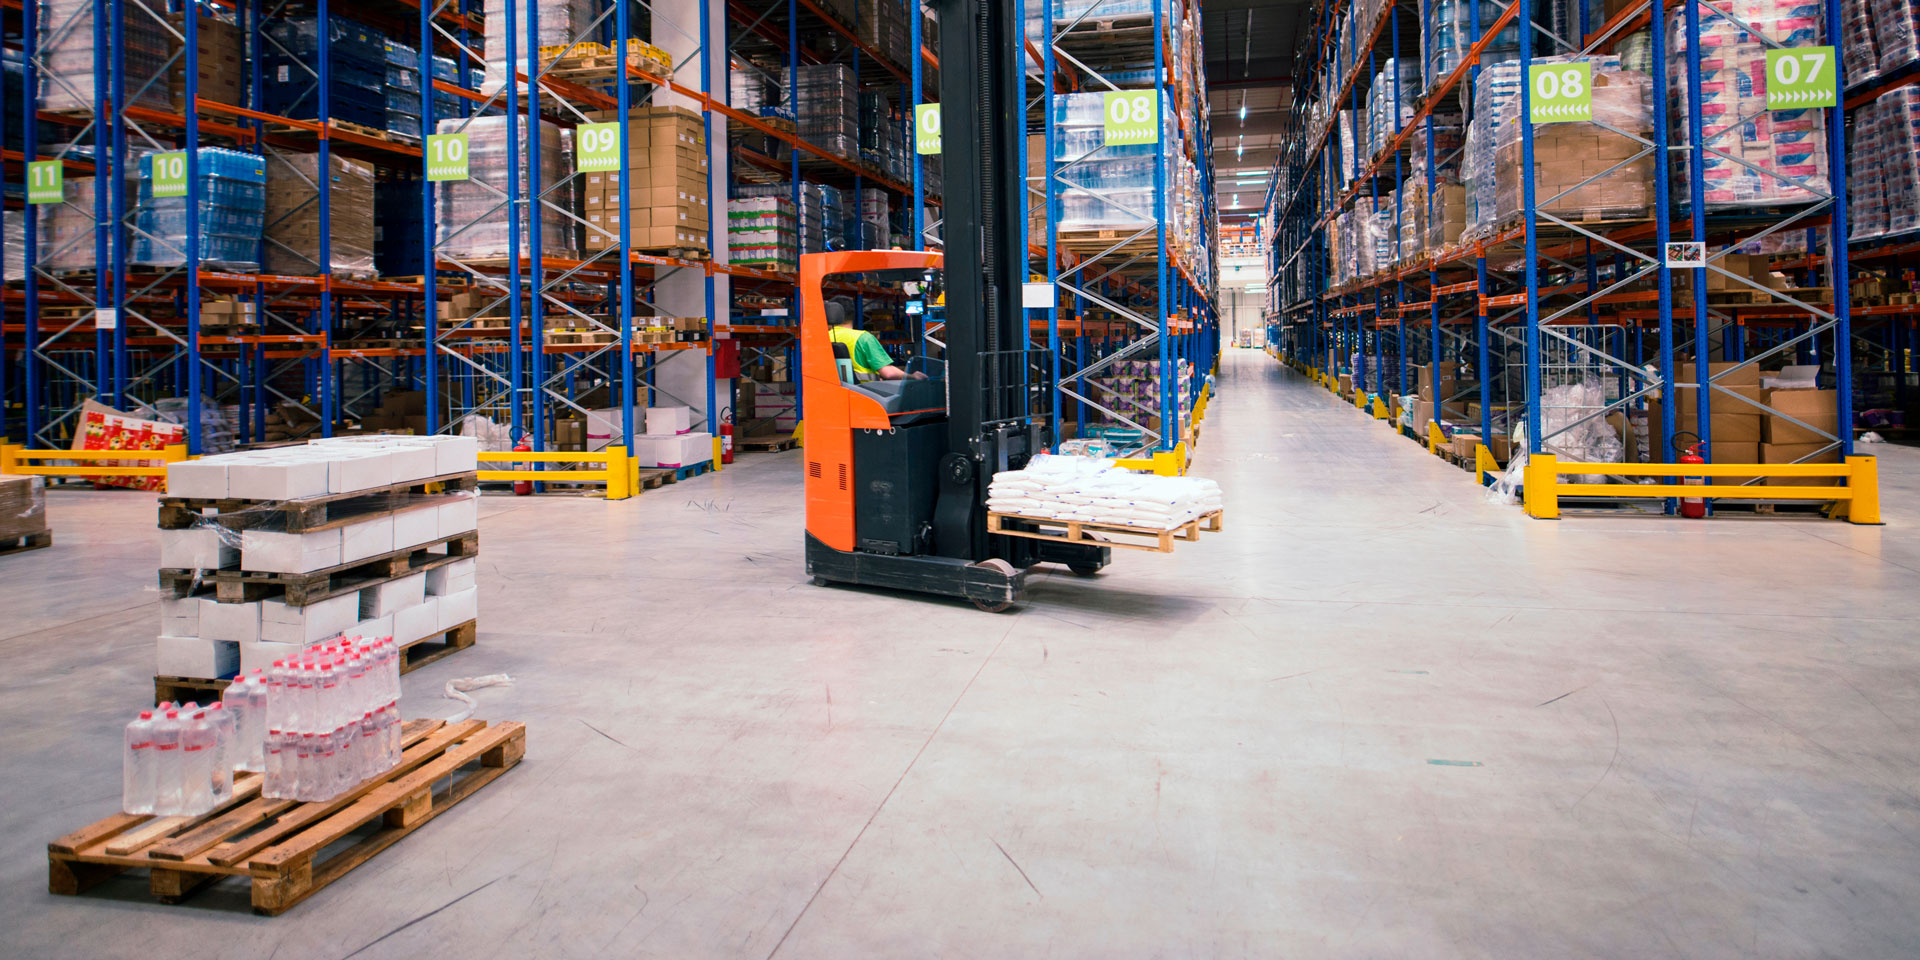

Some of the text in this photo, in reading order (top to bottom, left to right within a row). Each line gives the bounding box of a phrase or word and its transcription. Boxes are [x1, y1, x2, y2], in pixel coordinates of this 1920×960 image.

[1775, 54, 1826, 84] 07
[1536, 70, 1583, 99] 08
[922, 109, 941, 134] 0
[1109, 95, 1152, 125] 08
[432, 138, 464, 163] 10
[582, 128, 615, 153] 09
[32, 165, 55, 187] 11
[157, 157, 183, 180] 10
